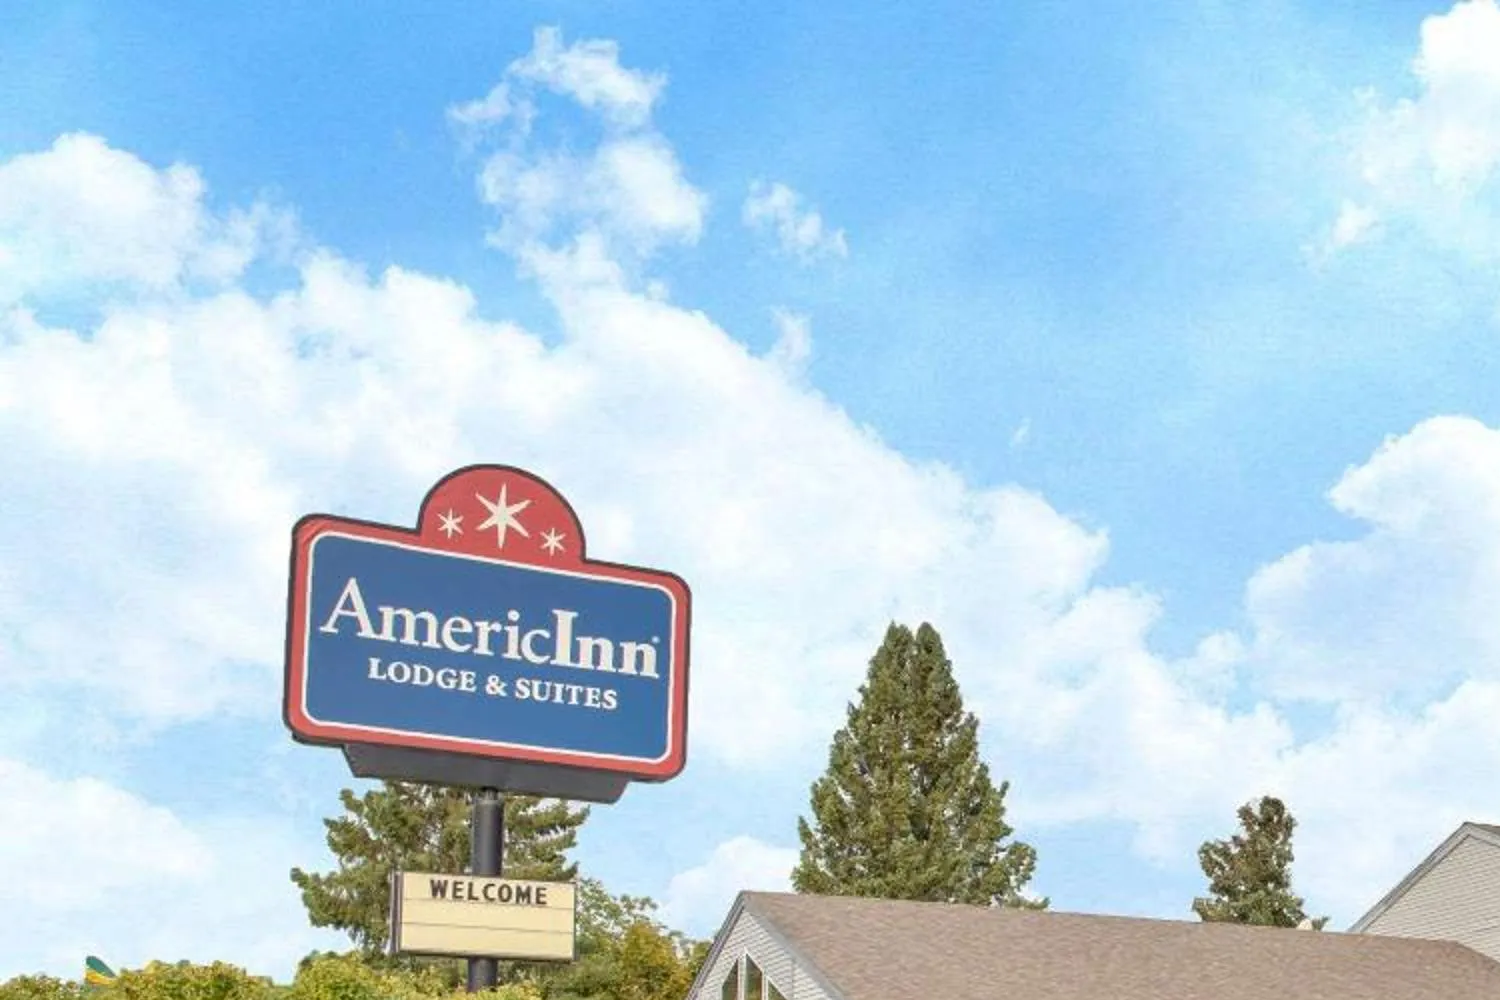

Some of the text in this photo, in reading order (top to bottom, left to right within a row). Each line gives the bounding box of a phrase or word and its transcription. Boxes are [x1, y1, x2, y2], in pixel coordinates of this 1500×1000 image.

[319, 576, 661, 679] AmericInn
[367, 656, 618, 711] LODGE & SUITES
[430, 878, 549, 905] WELCOME
